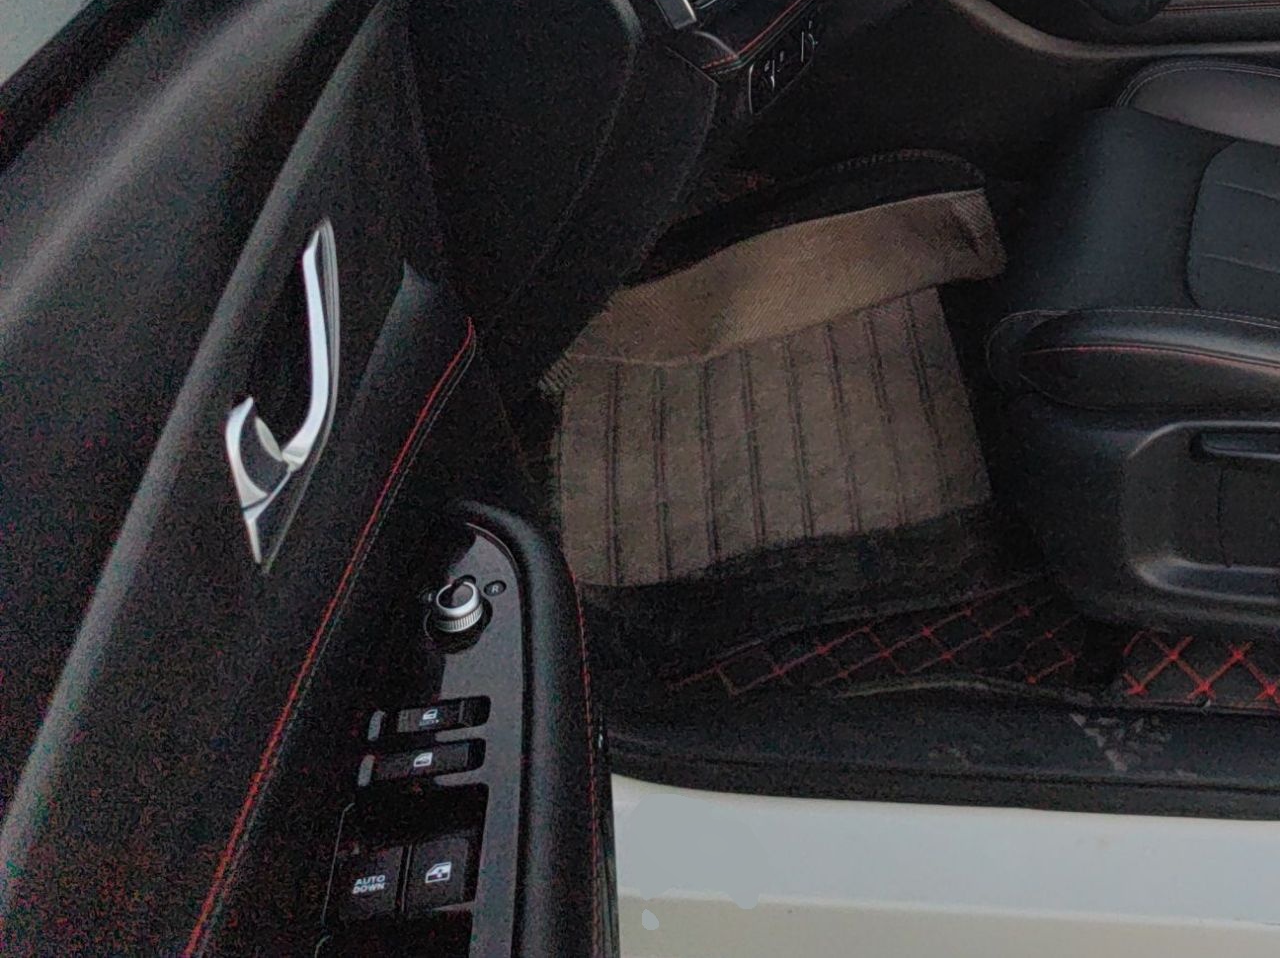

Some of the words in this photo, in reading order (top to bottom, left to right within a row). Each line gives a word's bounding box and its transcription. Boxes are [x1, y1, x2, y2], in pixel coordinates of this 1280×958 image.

[491, 585, 499, 594] R
[354, 874, 386, 886] AUTO
[352, 882, 385, 894] DOWN
